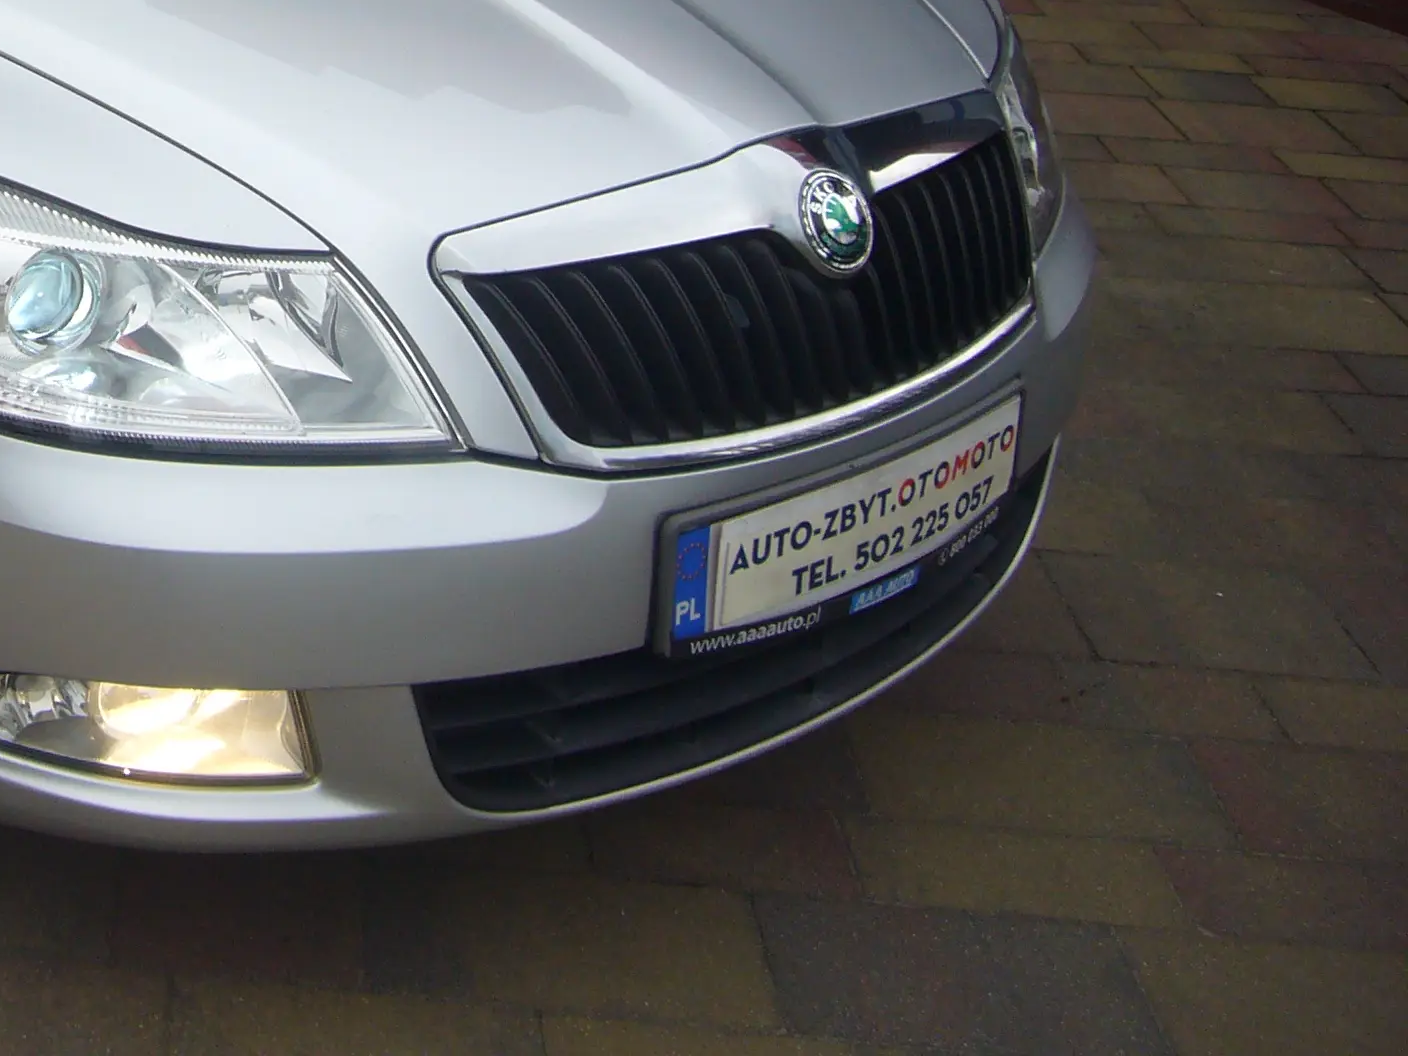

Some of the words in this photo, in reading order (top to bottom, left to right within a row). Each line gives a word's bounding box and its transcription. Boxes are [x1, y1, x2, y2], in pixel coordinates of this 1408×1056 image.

[729, 424, 1015, 575] AUTO-ZBYT.OTOMOTO
[792, 558, 847, 596] TEL.
[855, 528, 905, 572] 502
[909, 502, 950, 547] 225
[955, 475, 995, 520] 057
[675, 599, 701, 626] PL
[689, 607, 823, 655] www.aaaauto.pl
